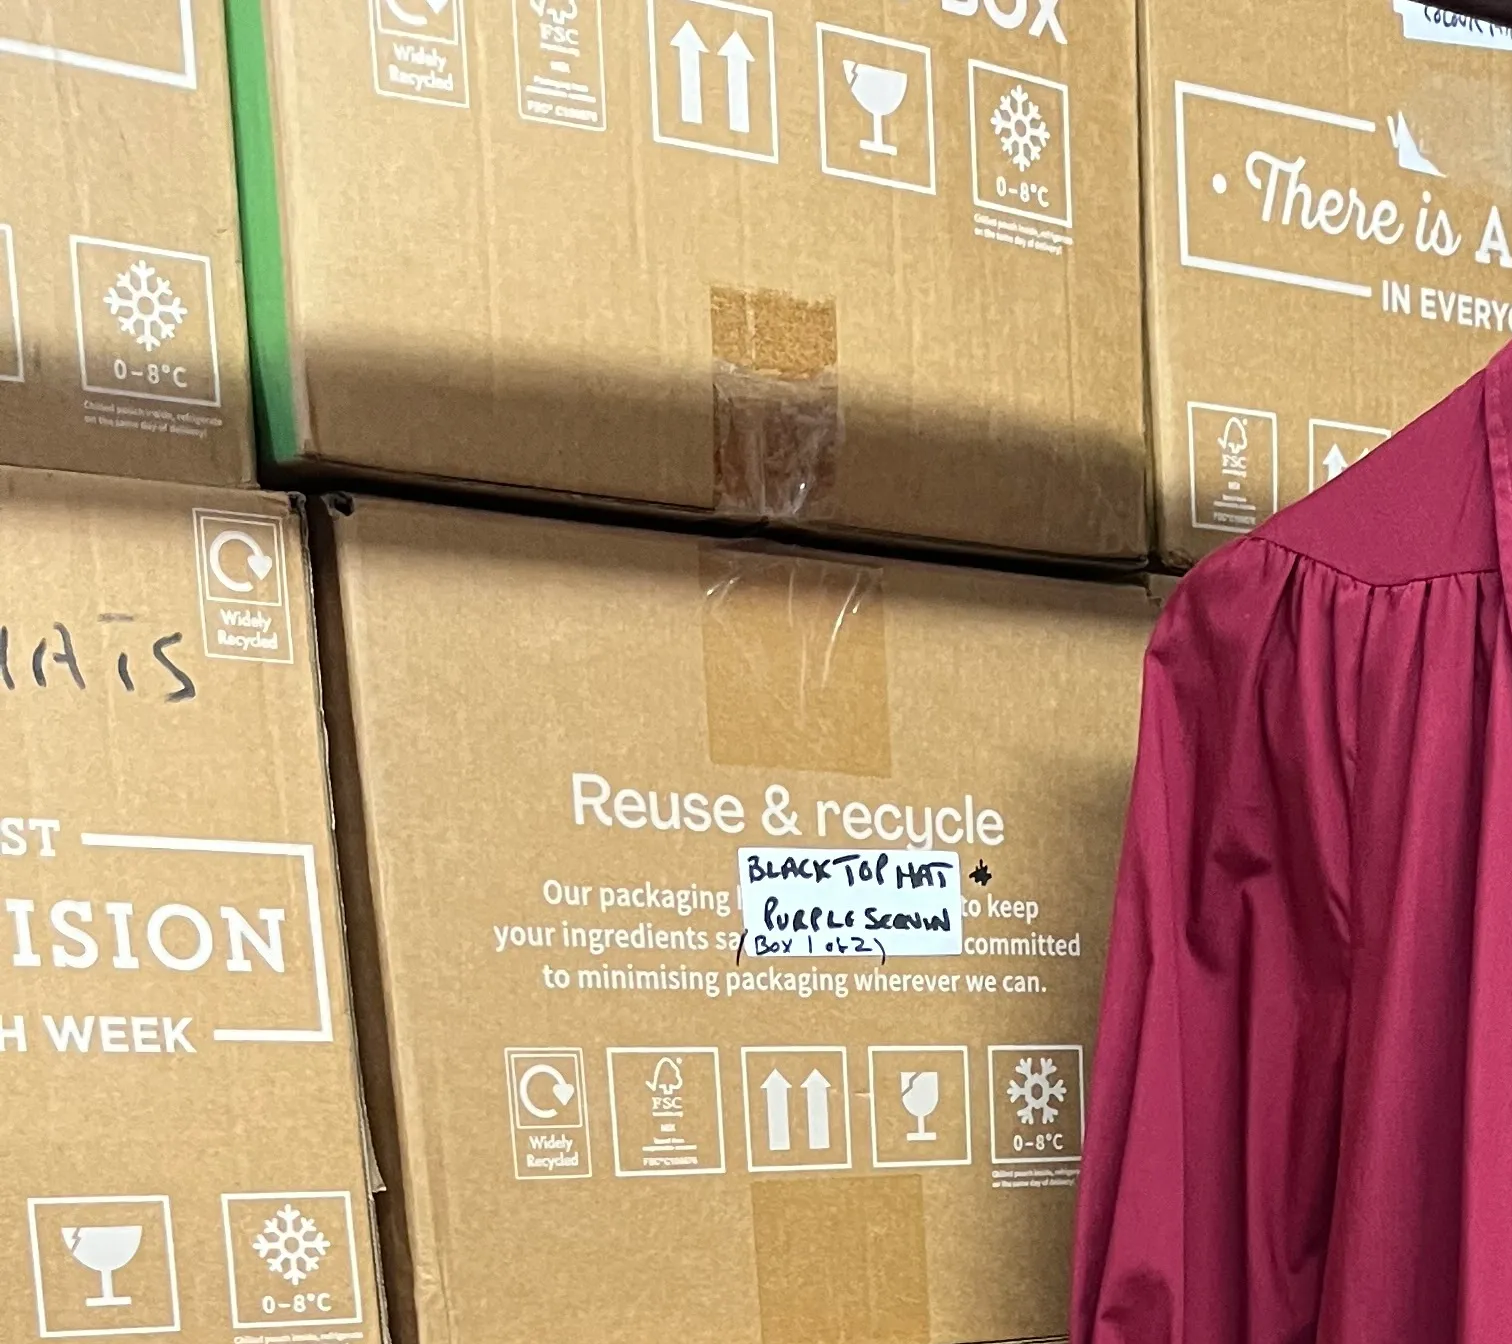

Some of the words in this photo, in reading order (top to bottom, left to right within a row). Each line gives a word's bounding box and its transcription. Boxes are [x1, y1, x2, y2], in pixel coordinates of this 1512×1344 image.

[539, 23, 579, 45] FSC
[393, 43, 446, 73] Widely
[388, 65, 454, 91] Recycled
[1246, 150, 1405, 246] There
[1416, 190, 1462, 257] is
[1382, 280, 1411, 315] IN
[220, 609, 273, 632] Widely
[217, 630, 278, 651] Recycled
[572, 772, 745, 833] Reuse
[761, 784, 802, 836] &
[817, 795, 1004, 850] recycle
[747, 855, 831, 882] BLACK
[833, 853, 888, 886] TOP
[896, 861, 953, 888] HAT
[543, 880, 592, 905] Our
[600, 881, 730, 917] packaging
[764, 897, 854, 931] PURPLE
[987, 894, 1039, 923] keep
[6, 899, 285, 972] ISION
[494, 924, 555, 952] your
[562, 921, 708, 955] ingredients
[964, 933, 1080, 956] committed
[542, 965, 570, 988] to
[578, 963, 720, 997] minimising
[726, 967, 849, 998] packaging
[854, 967, 961, 992] wherever
[966, 974, 997, 992] we
[1003, 973, 1047, 992] can.
[43, 1015, 197, 1054] WEEK
[652, 1097, 683, 1110] FSC
[529, 1134, 573, 1152] Widely
[526, 1152, 579, 1170] Recycled
